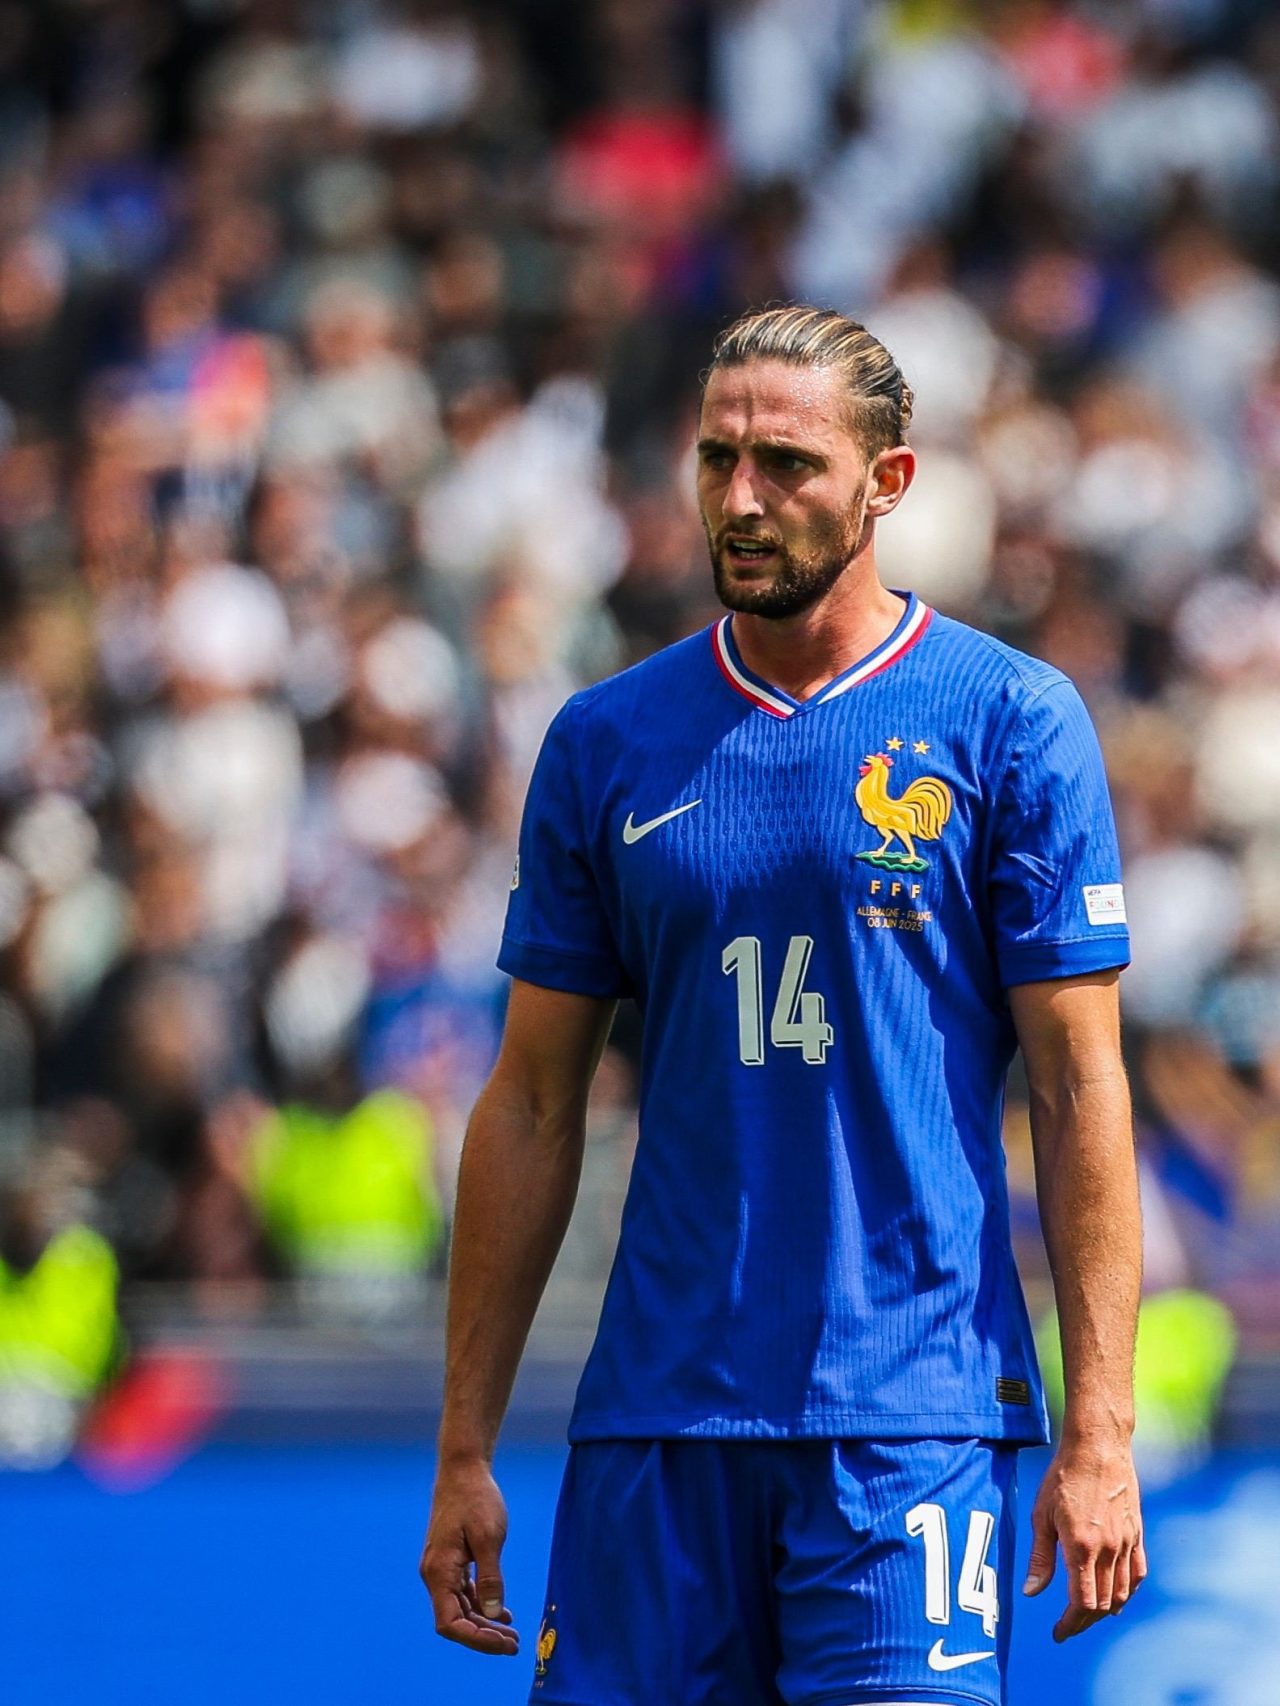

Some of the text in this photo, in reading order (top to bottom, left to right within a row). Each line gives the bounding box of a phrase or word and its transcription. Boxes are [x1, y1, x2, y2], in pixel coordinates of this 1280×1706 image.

[857, 906, 899, 917] ALLEMAGNE
[899, 920, 924, 931] 2025
[722, 935, 834, 1065] 14
[905, 1503, 999, 1639] 14
